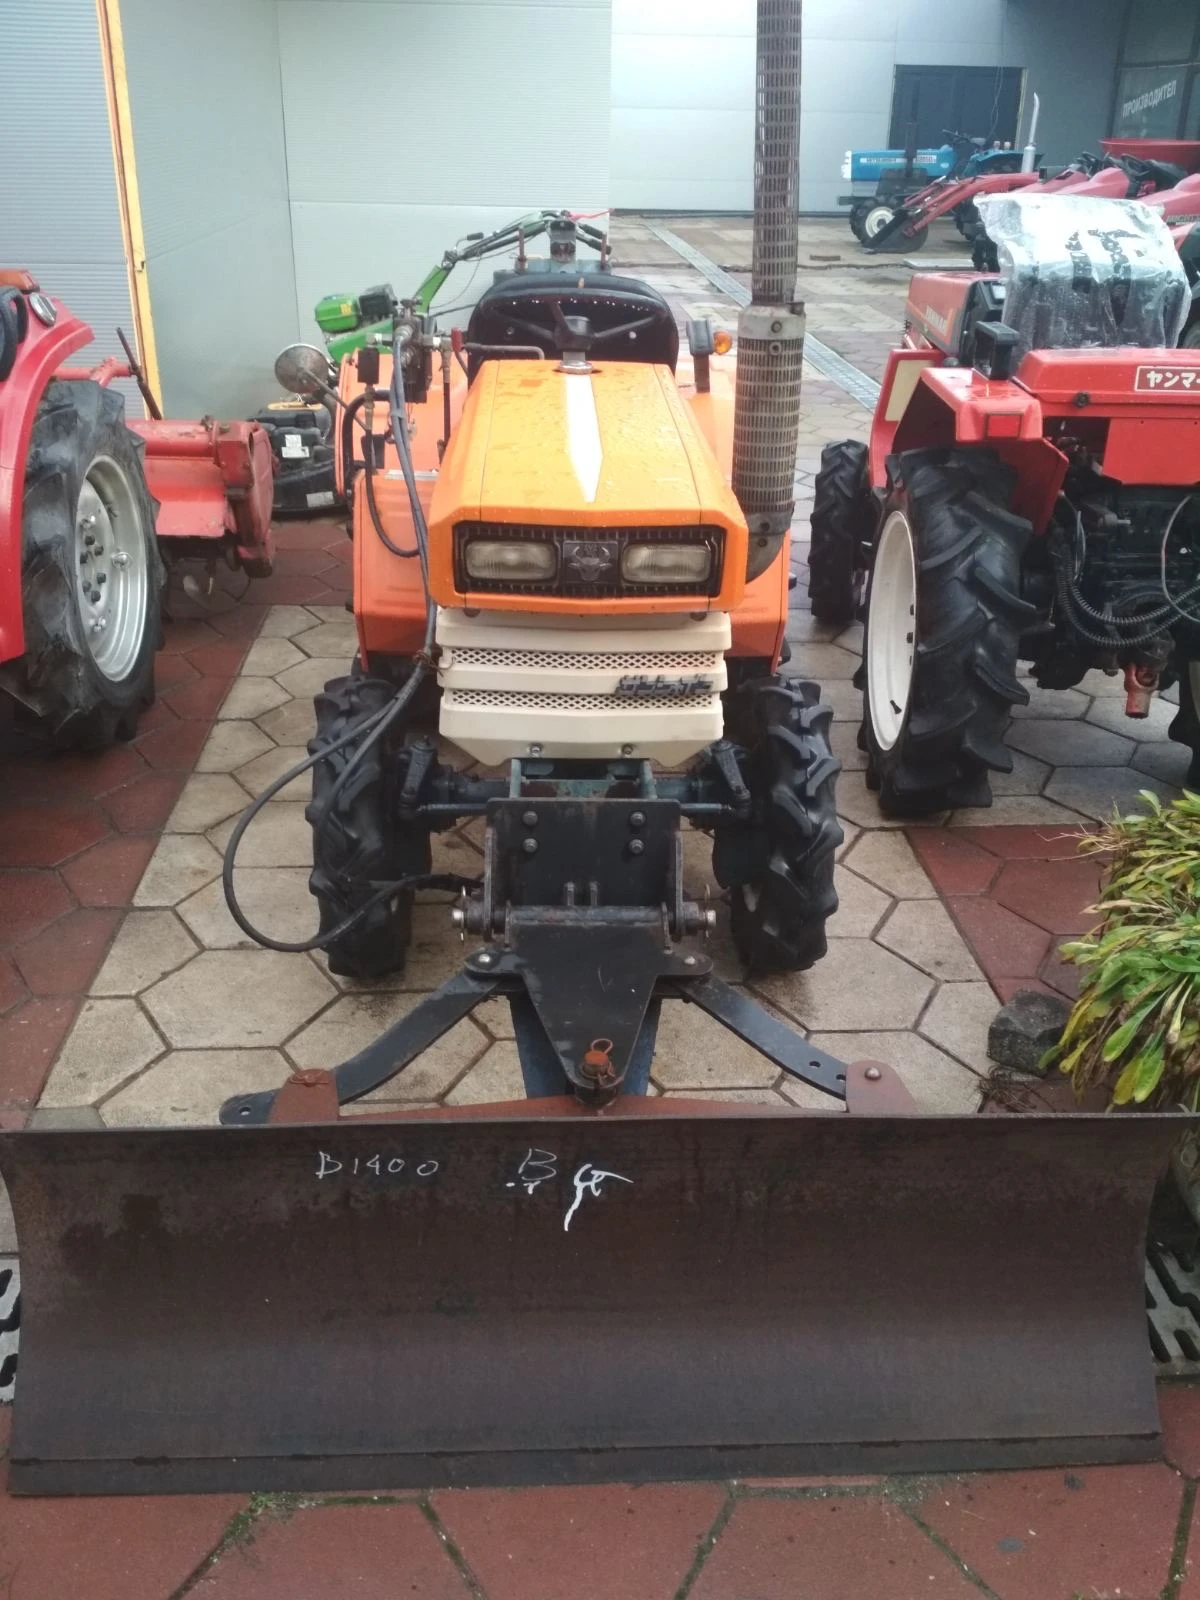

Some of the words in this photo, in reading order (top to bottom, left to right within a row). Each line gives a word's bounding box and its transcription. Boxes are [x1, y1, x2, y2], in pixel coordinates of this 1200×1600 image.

[1122, 79, 1177, 119] ПРОИЗВОДИТЕЛ
[1146, 370, 1200, 388] ヤンマ
